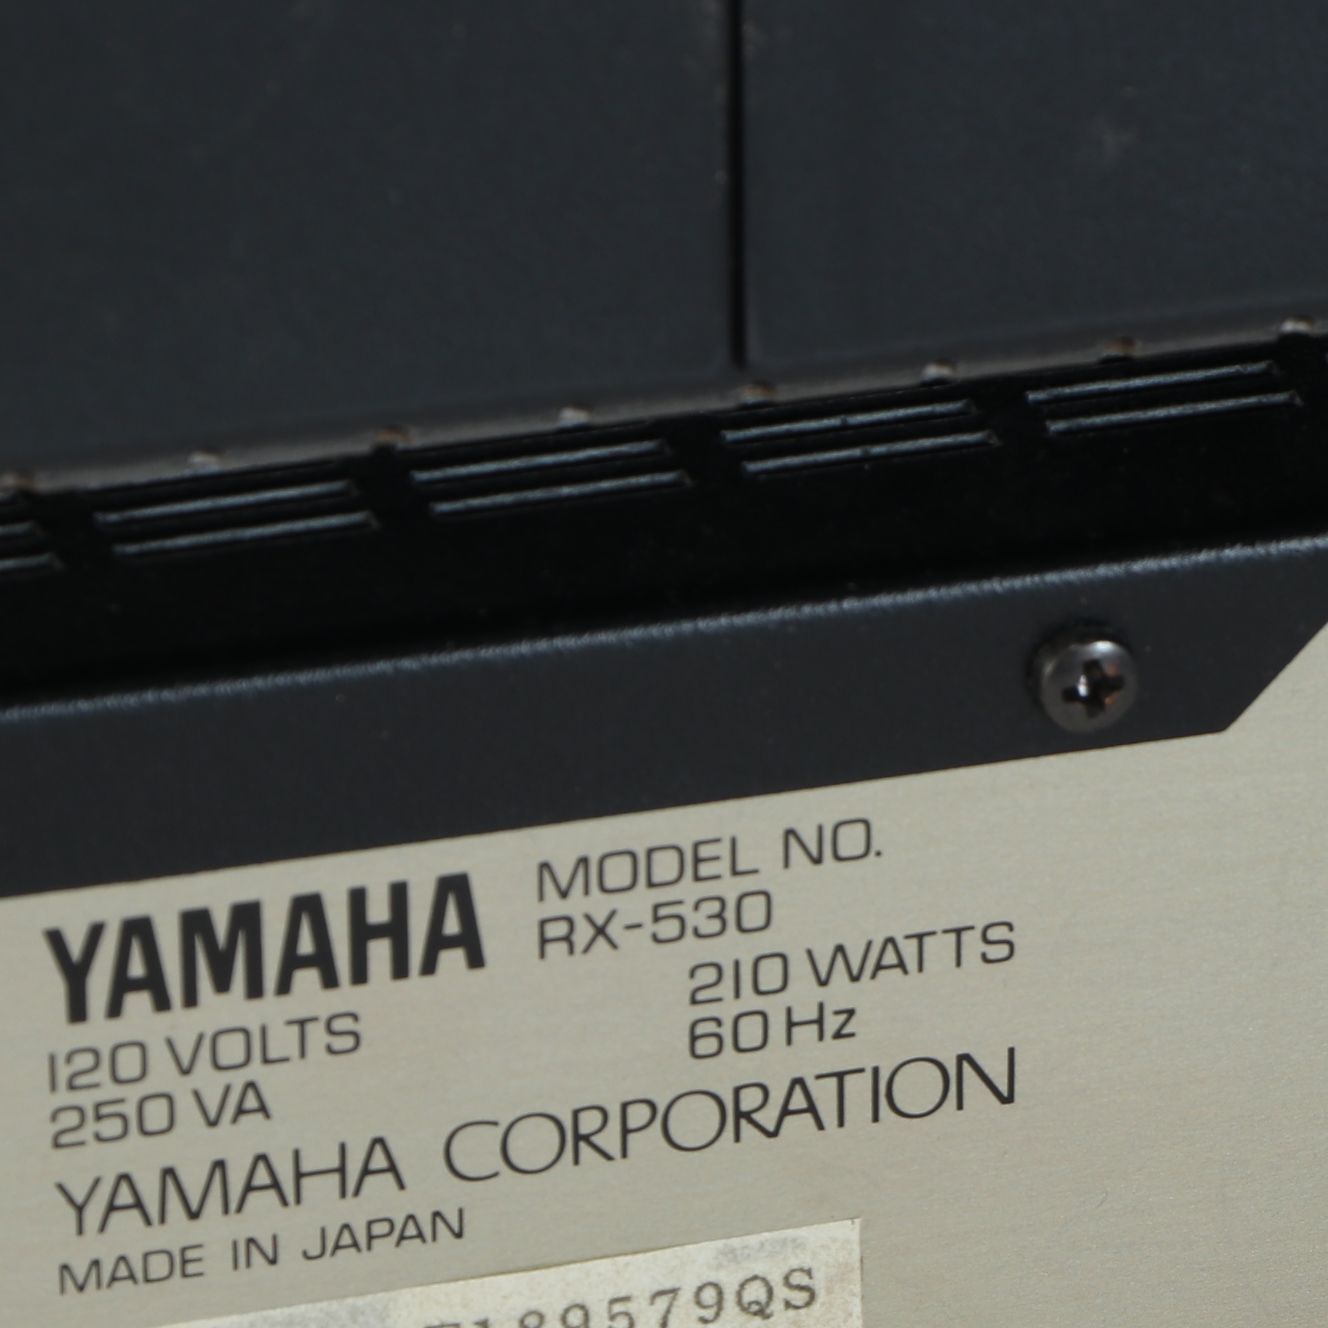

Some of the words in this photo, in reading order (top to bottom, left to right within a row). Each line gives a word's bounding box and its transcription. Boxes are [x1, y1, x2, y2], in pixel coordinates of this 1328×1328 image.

[537, 836, 759, 902] MODEL
[782, 818, 882, 869] NO.
[43, 872, 486, 1024] YAMAHA
[538, 890, 772, 960] RX-530
[688, 952, 789, 1006] 210
[806, 921, 1015, 988] WATTS
[49, 1042, 148, 1093] 120
[165, 1011, 362, 1077] VOLTS
[50, 1093, 176, 1150] 250
[192, 1081, 272, 1128] VA
[55, 1135, 406, 1237] YAMAHA
[442, 1046, 1016, 1183] CORPORATION
[58, 1244, 206, 1295] MADE
[232, 1233, 279, 1271] IN
[302, 1207, 464, 1261] JAPAN
